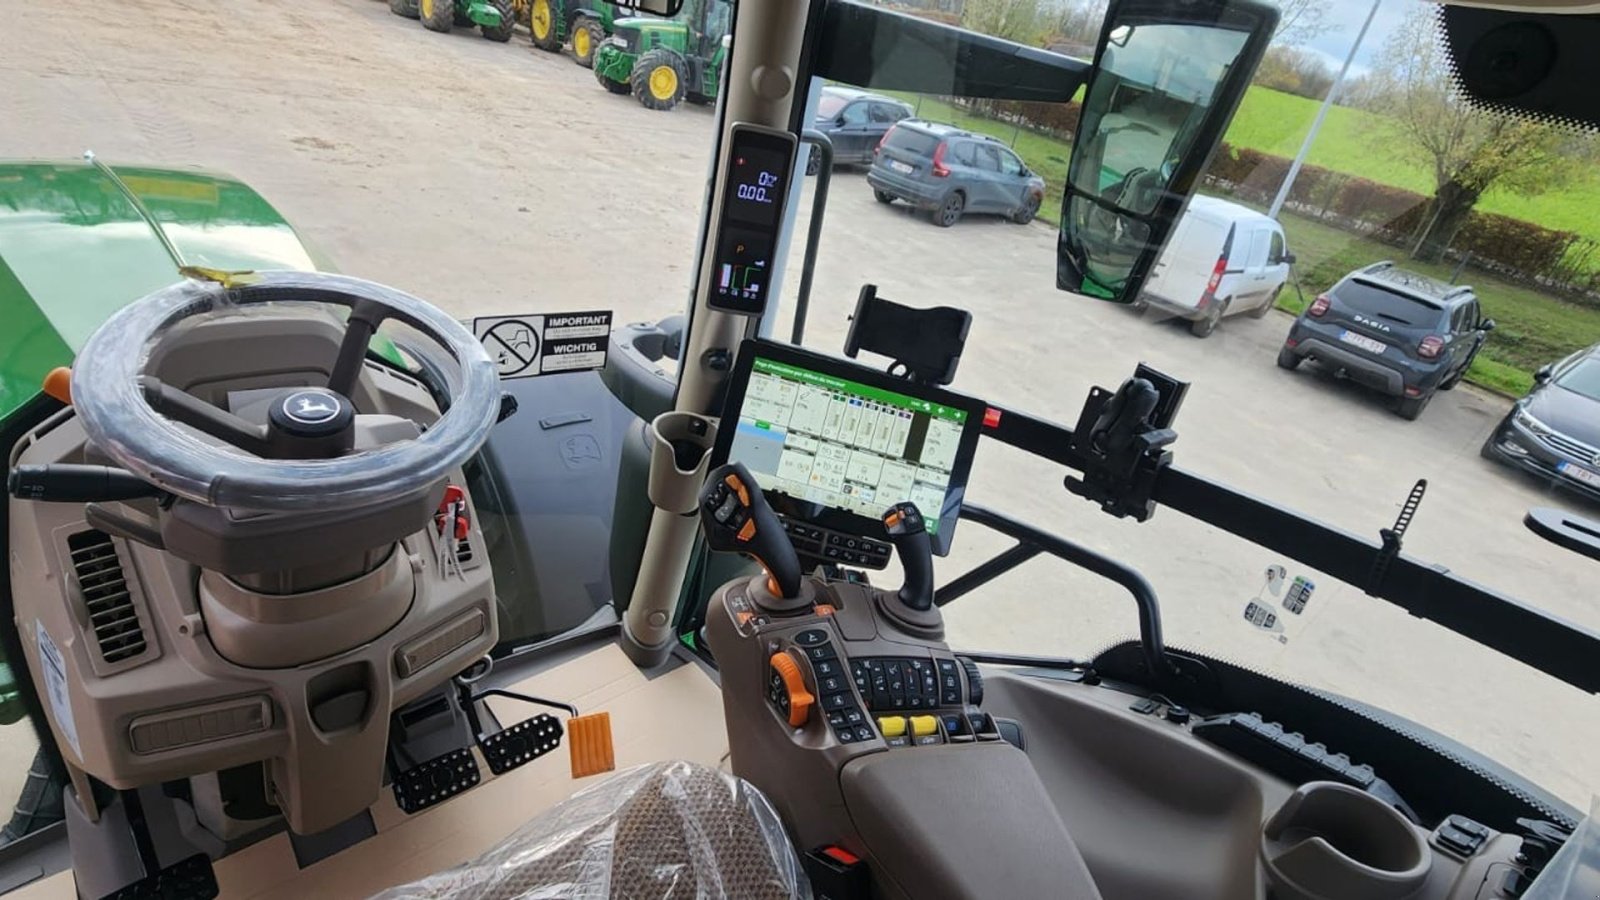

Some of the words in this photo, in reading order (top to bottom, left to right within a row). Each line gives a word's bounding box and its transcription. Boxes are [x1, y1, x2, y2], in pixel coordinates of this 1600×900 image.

[549, 315, 608, 327] IMPORTANT
[1353, 314, 1390, 332] DACIA
[553, 342, 597, 354] WICHTIG
